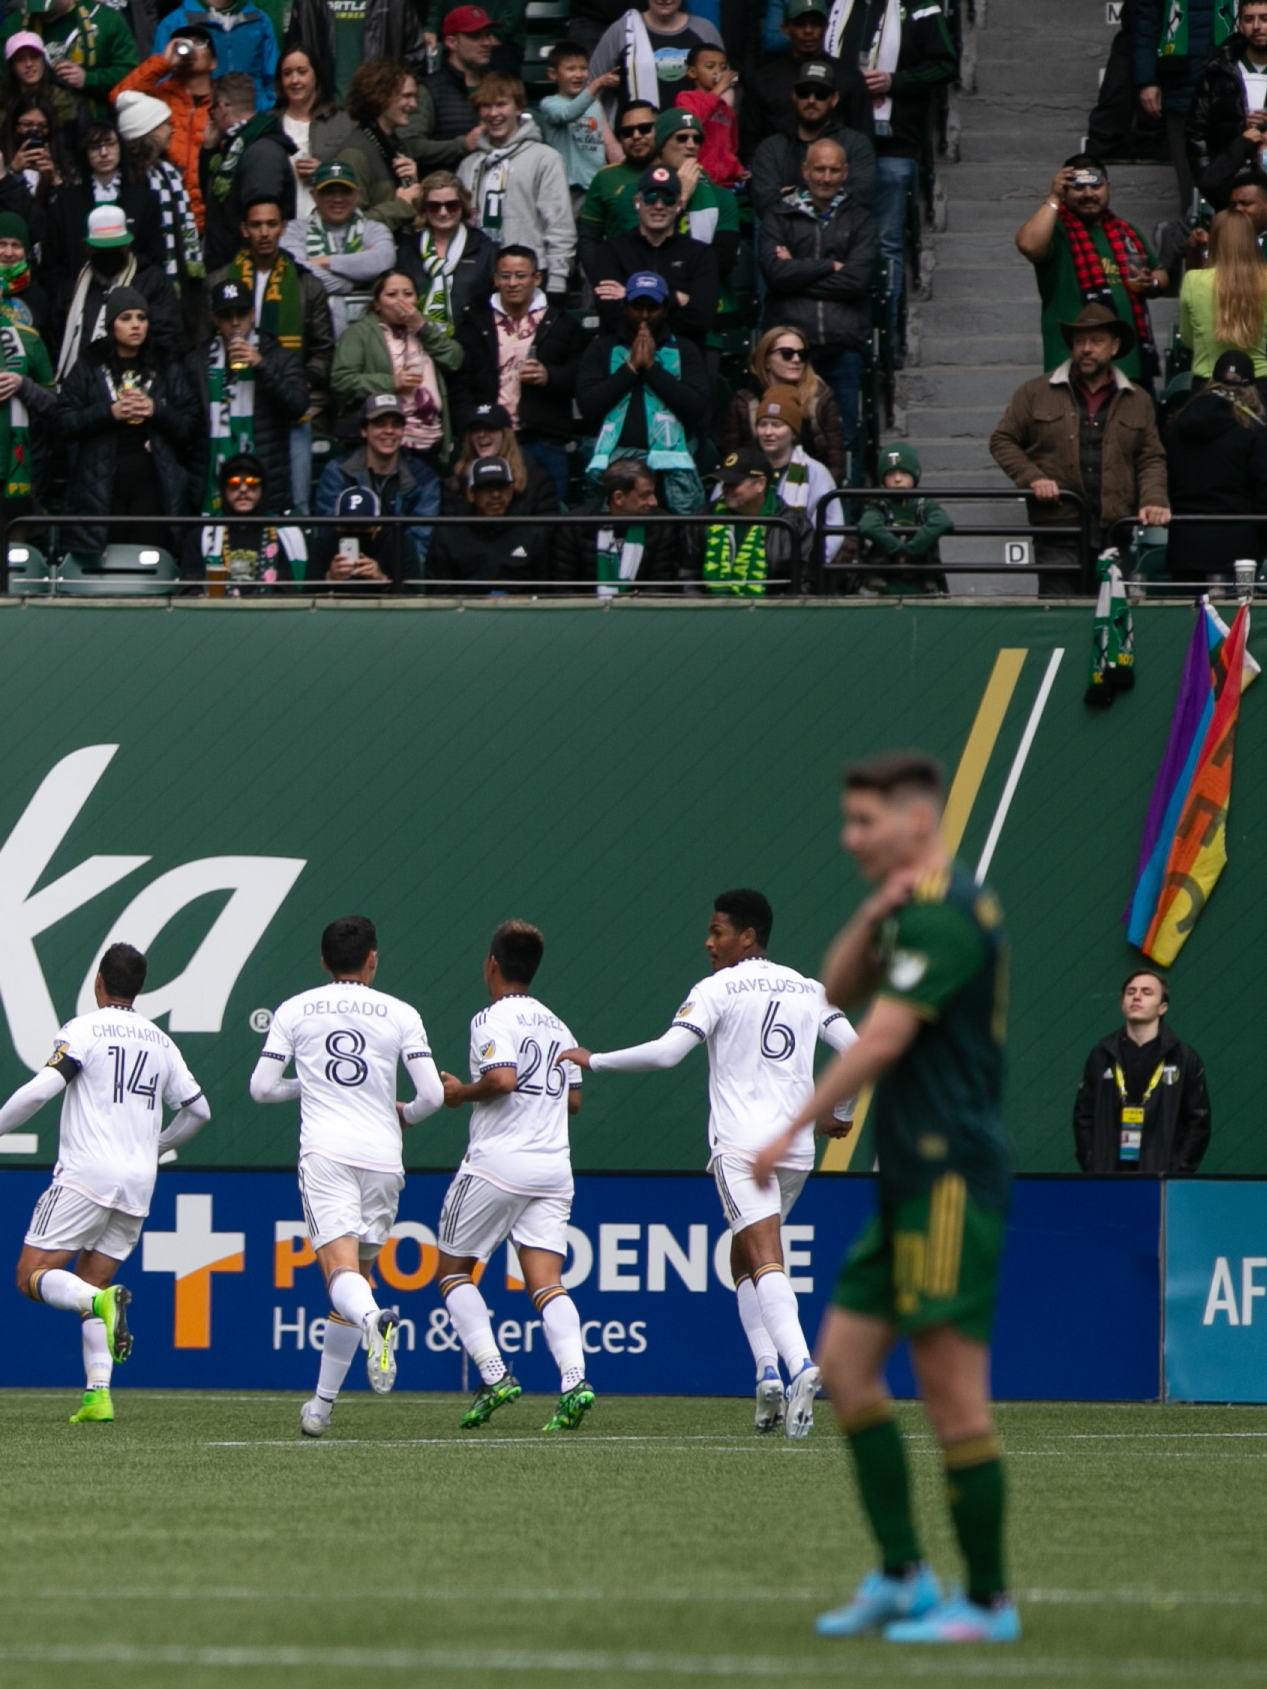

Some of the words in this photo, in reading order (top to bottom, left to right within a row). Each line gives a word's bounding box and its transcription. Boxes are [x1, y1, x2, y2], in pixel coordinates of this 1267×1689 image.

[1009, 544, 1025, 562] D
[92, 1024, 170, 1049] CHICHARITO
[303, 1000, 388, 1018] DELGADO
[761, 1001, 795, 1062] 6
[108, 1045, 160, 1110] 14
[325, 1028, 368, 1087] 8
[515, 1036, 566, 1100] 26
